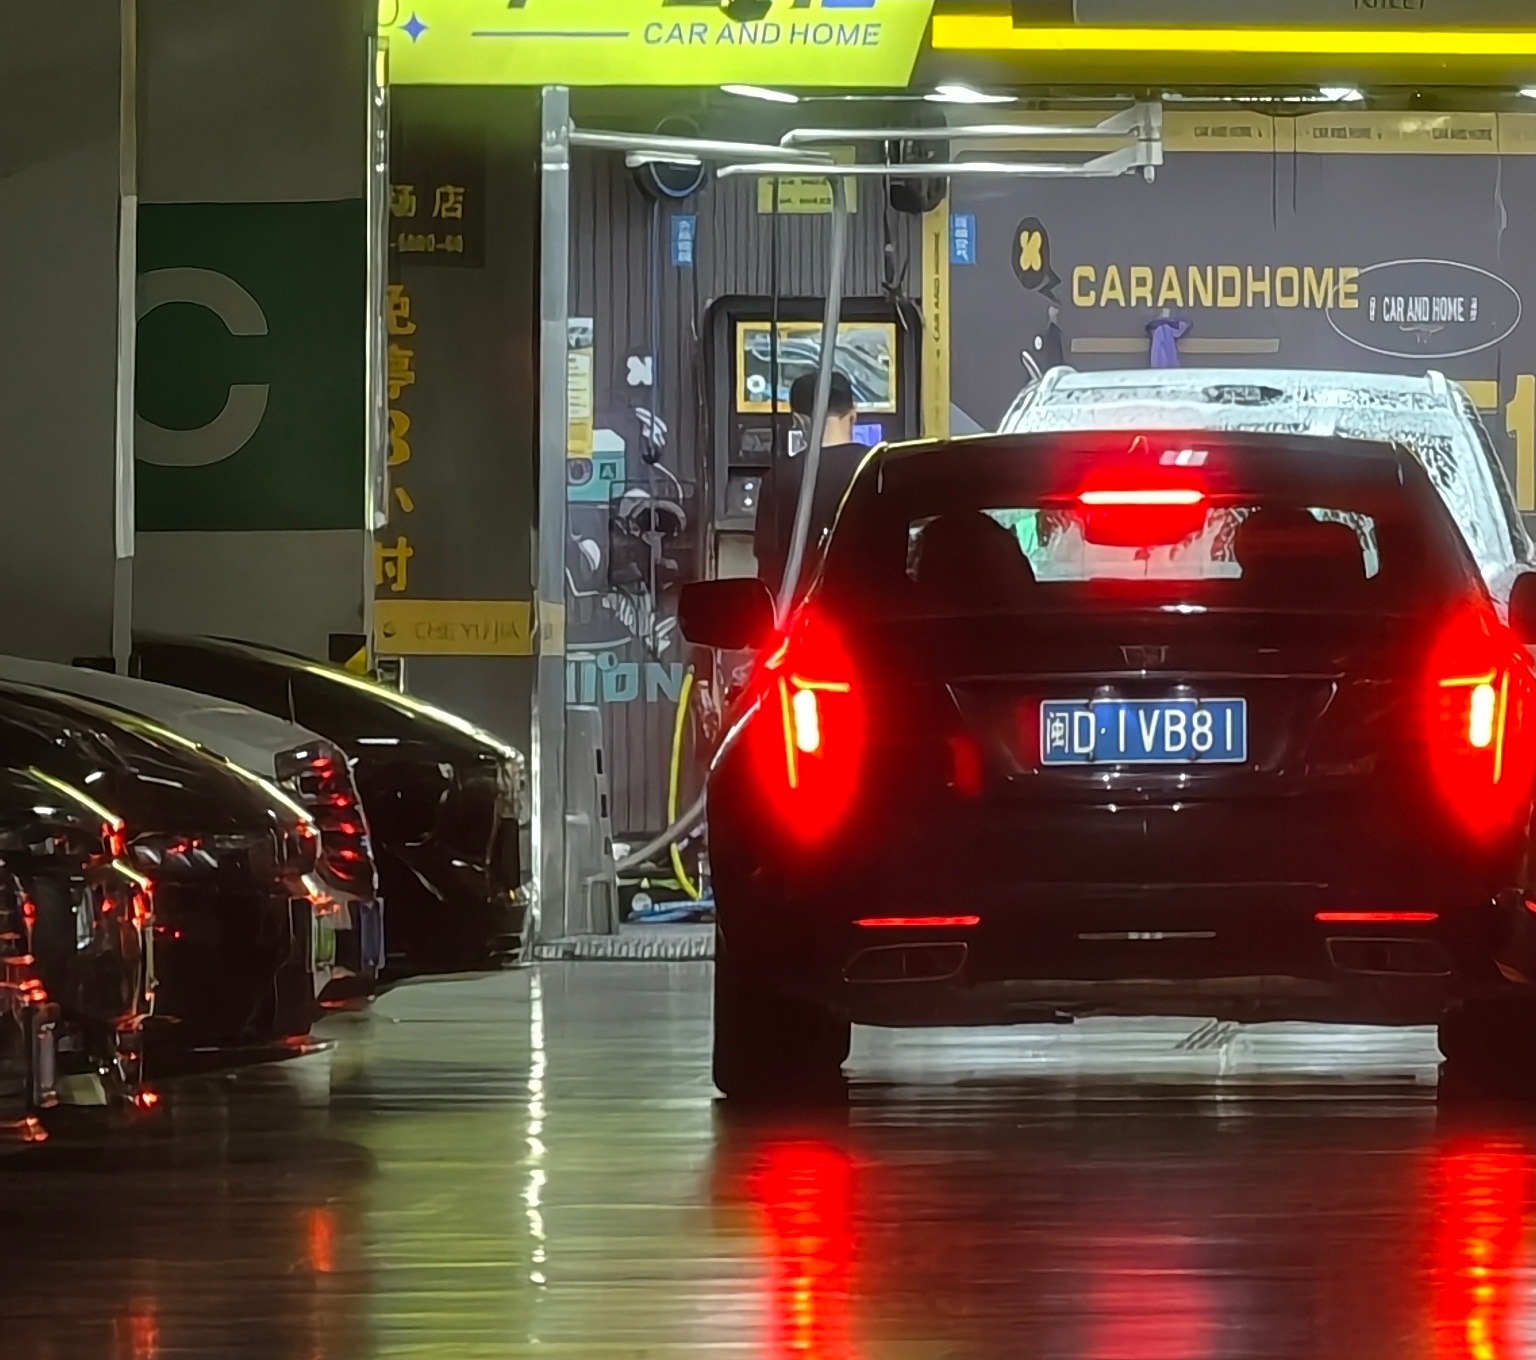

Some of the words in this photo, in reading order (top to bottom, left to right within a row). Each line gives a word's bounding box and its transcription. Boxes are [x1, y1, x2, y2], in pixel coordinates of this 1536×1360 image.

[644, 22, 709, 46] CAR
[715, 22, 782, 46] AND
[789, 22, 882, 47] HOME
[1071, 264, 1361, 309] CARANDHOME
[1382, 296, 1404, 322] CAR
[1406, 296, 1430, 322] AND
[1432, 296, 1465, 322] HOME
